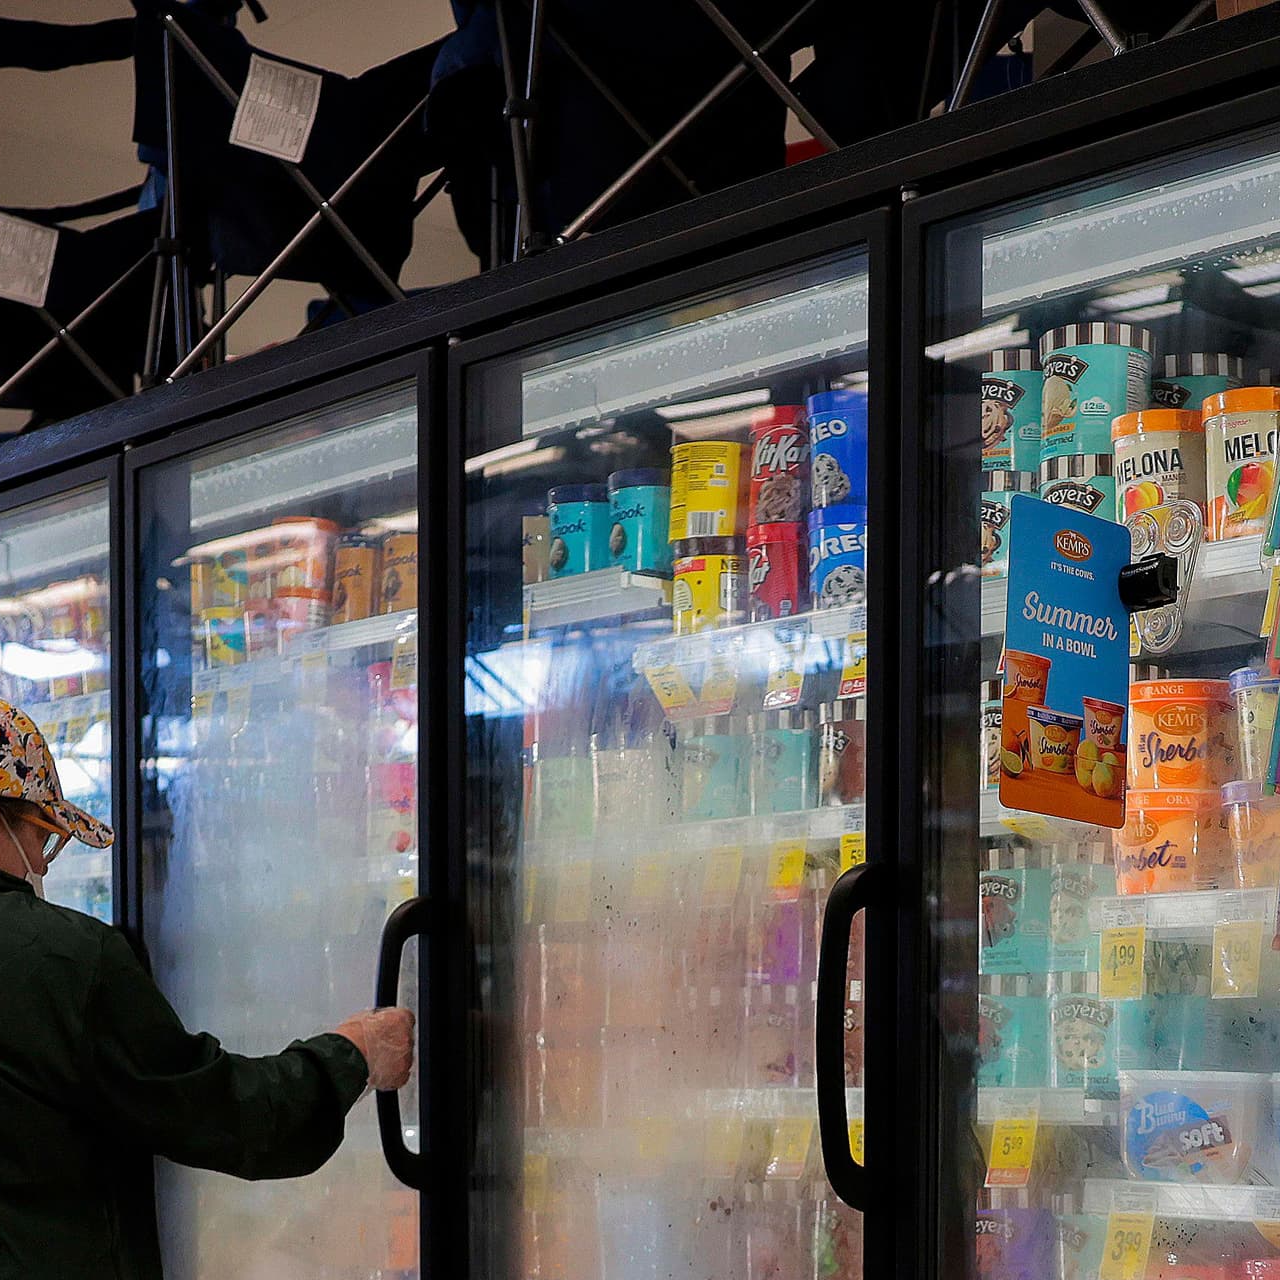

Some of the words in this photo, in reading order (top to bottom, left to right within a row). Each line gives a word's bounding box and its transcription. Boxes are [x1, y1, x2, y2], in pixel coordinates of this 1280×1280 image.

[1116, 448, 1183, 482] MELONA
[1056, 535, 1090, 556] KEMPS
[1050, 561, 1062, 570] IT'S
[1062, 565, 1074, 574] THE
[1023, 591, 1117, 640] Summer
[1042, 633, 1054, 648] IN
[1056, 636, 1064, 650] A
[1067, 638, 1096, 658] BOWL
[1140, 684, 1184, 695] ORANGE
[1091, 719, 1117, 736] Sherbet
[1158, 711, 1204, 727] KEMPS
[1039, 738, 1071, 755] Sherbet
[1178, 1121, 1224, 1151] soft
